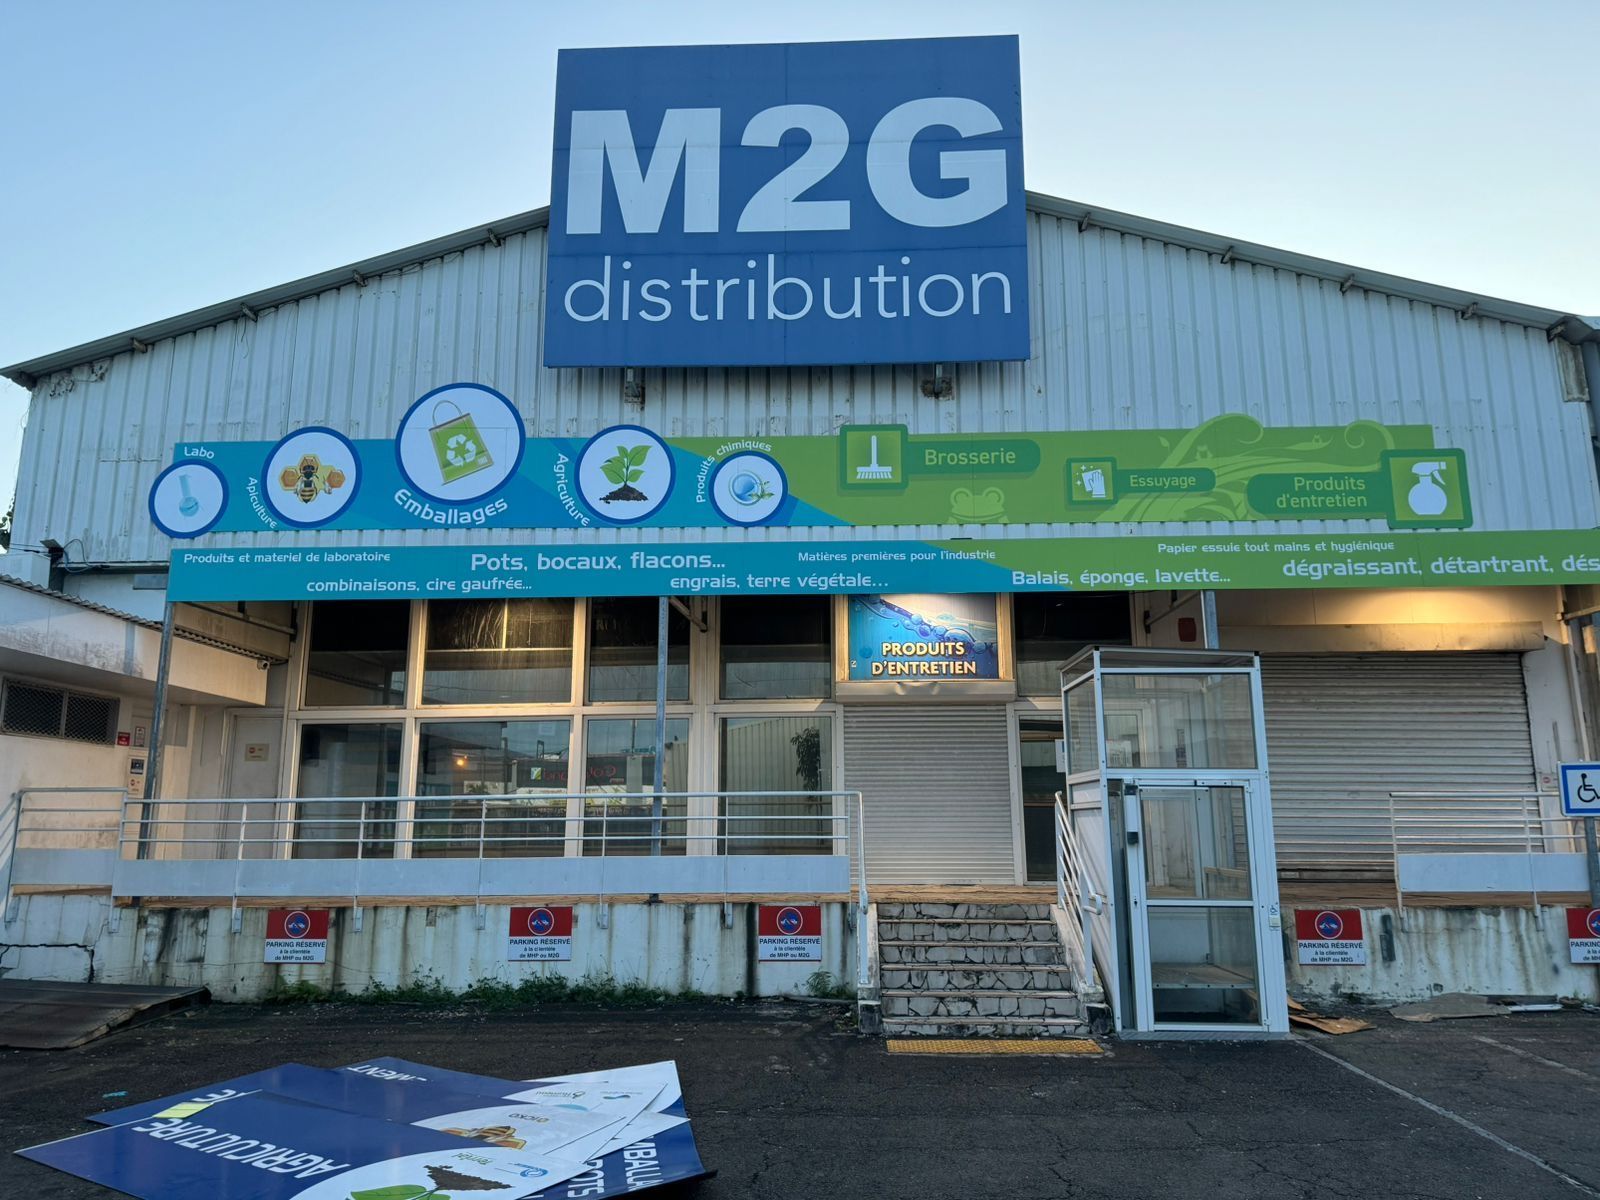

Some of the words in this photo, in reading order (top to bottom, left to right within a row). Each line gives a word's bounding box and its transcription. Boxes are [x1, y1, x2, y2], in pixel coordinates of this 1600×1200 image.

[566, 97, 1008, 235] M2G
[564, 253, 1012, 322] distribution
[183, 446, 215, 459] Labo
[925, 448, 1016, 465] Brosserie
[696, 455, 715, 503] Produits
[716, 440, 772, 457] chimiques
[553, 453, 590, 527] Agriculture
[1130, 474, 1197, 489] Essuyage
[1294, 476, 1366, 491] Produits
[245, 477, 278, 529] Apiculture
[394, 488, 508, 526] Emballages
[1276, 493, 1368, 509] d'entretien
[798, 551, 847, 562] Matières
[852, 551, 906, 563] premières
[910, 551, 937, 562] pour
[940, 550, 996, 560] l'industrie
[1158, 544, 1197, 555] Papier
[1201, 544, 1240, 553] essuie
[1245, 542, 1269, 552] tout
[1274, 542, 1310, 552] mains
[1315, 542, 1327, 552] et
[1331, 541, 1395, 553] hygiénique
[183, 553, 234, 564] Produits
[238, 553, 250, 563] et
[253, 552, 302, 563] materiel
[305, 552, 320, 562] de
[324, 551, 391, 562] laboratoire
[471, 553, 528, 572] Pots,
[537, 553, 622, 571] bocaux,
[631, 552, 726, 570] flacons...
[1282, 558, 1423, 580] dégraissant,
[1431, 555, 1554, 574] détartrant,
[1561, 554, 1600, 572] dés
[306, 578, 420, 593] combinaisons,
[426, 578, 456, 591] cire
[461, 577, 532, 593] gaufrée...
[670, 575, 740, 592] engrais,
[747, 575, 790, 588] terre
[797, 573, 889, 590] végétale...
[1012, 570, 1073, 586] Balais,
[1080, 569, 1149, 588] éponge,
[1155, 568, 1231, 583] lavette...
[882, 642, 965, 656] PRODUITS
[872, 661, 976, 676] D'ENTRETIEN
[132, 1118, 350, 1179] AGRICULTURE
